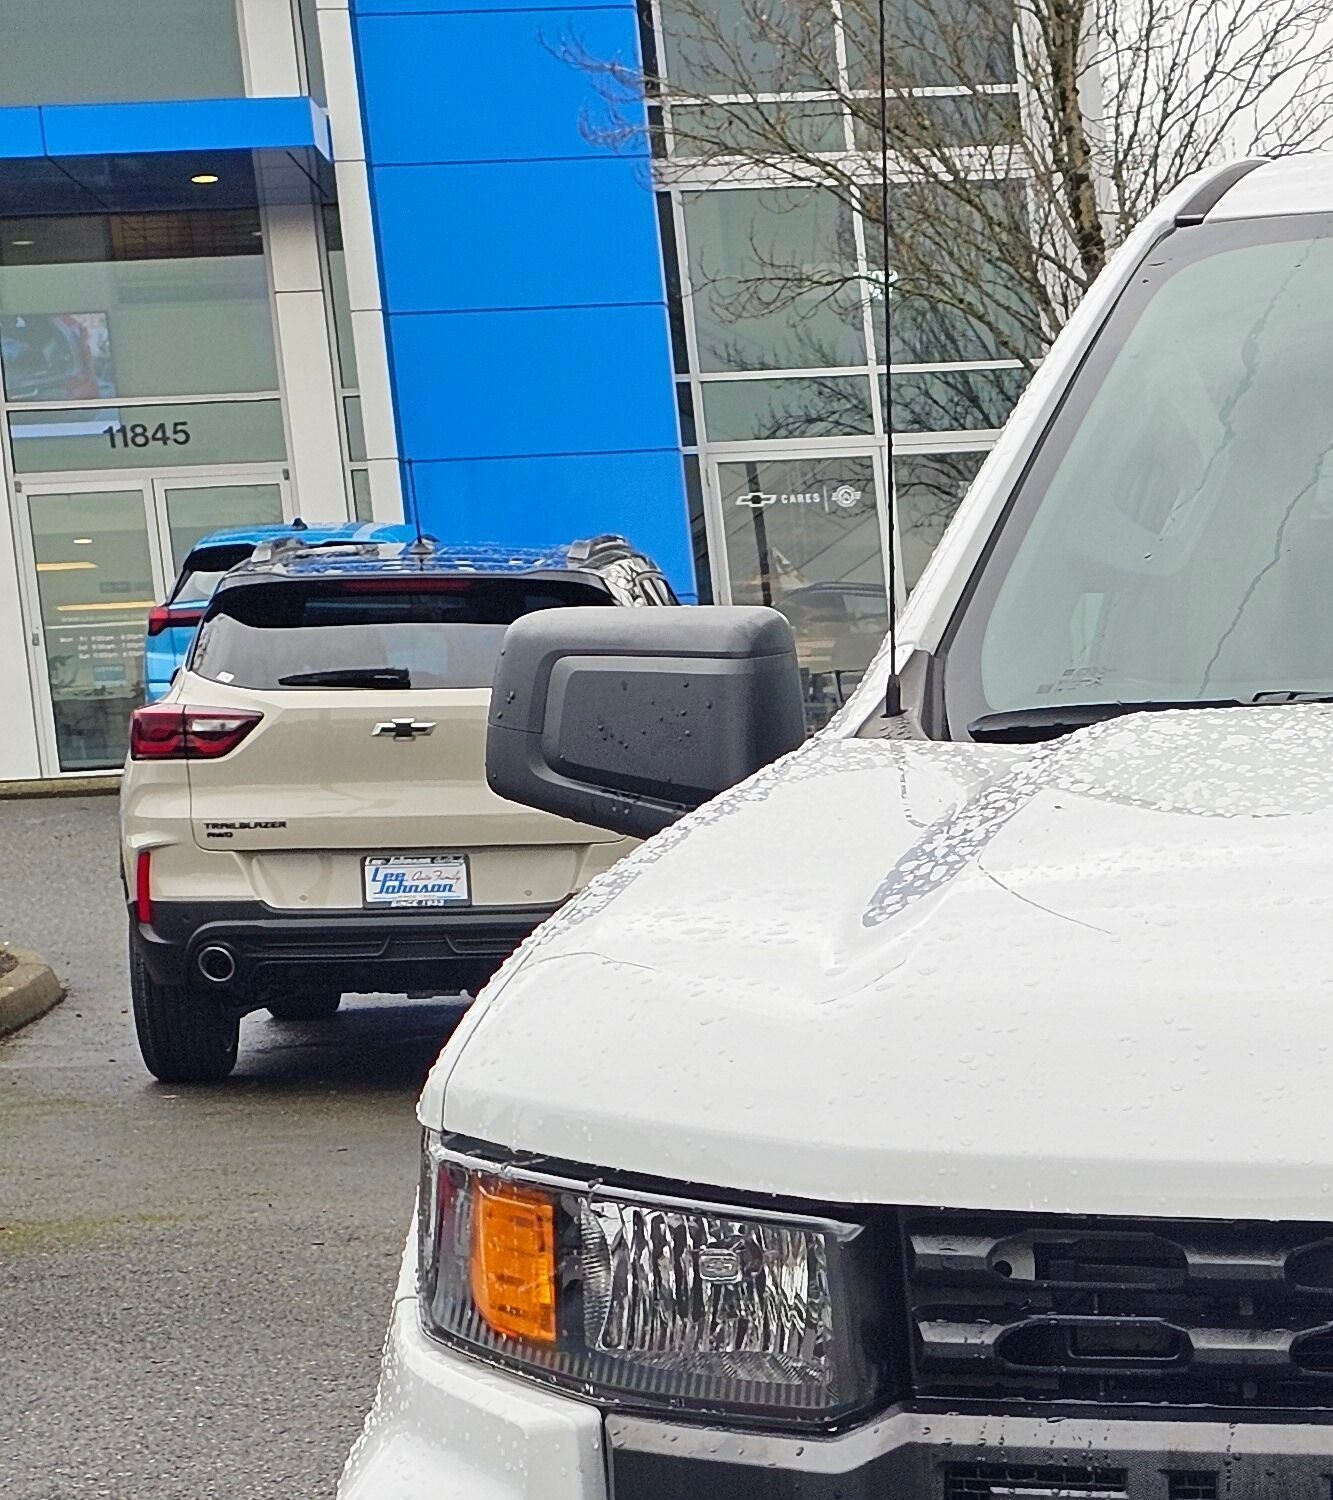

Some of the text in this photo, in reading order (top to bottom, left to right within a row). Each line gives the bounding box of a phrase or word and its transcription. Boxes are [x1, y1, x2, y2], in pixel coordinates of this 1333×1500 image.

[103, 421, 190, 448] 11845
[781, 493, 820, 504] CARES
[203, 821, 286, 830] TRAILBLAZER
[371, 867, 408, 883] Lee
[373, 877, 456, 894] Johnson
